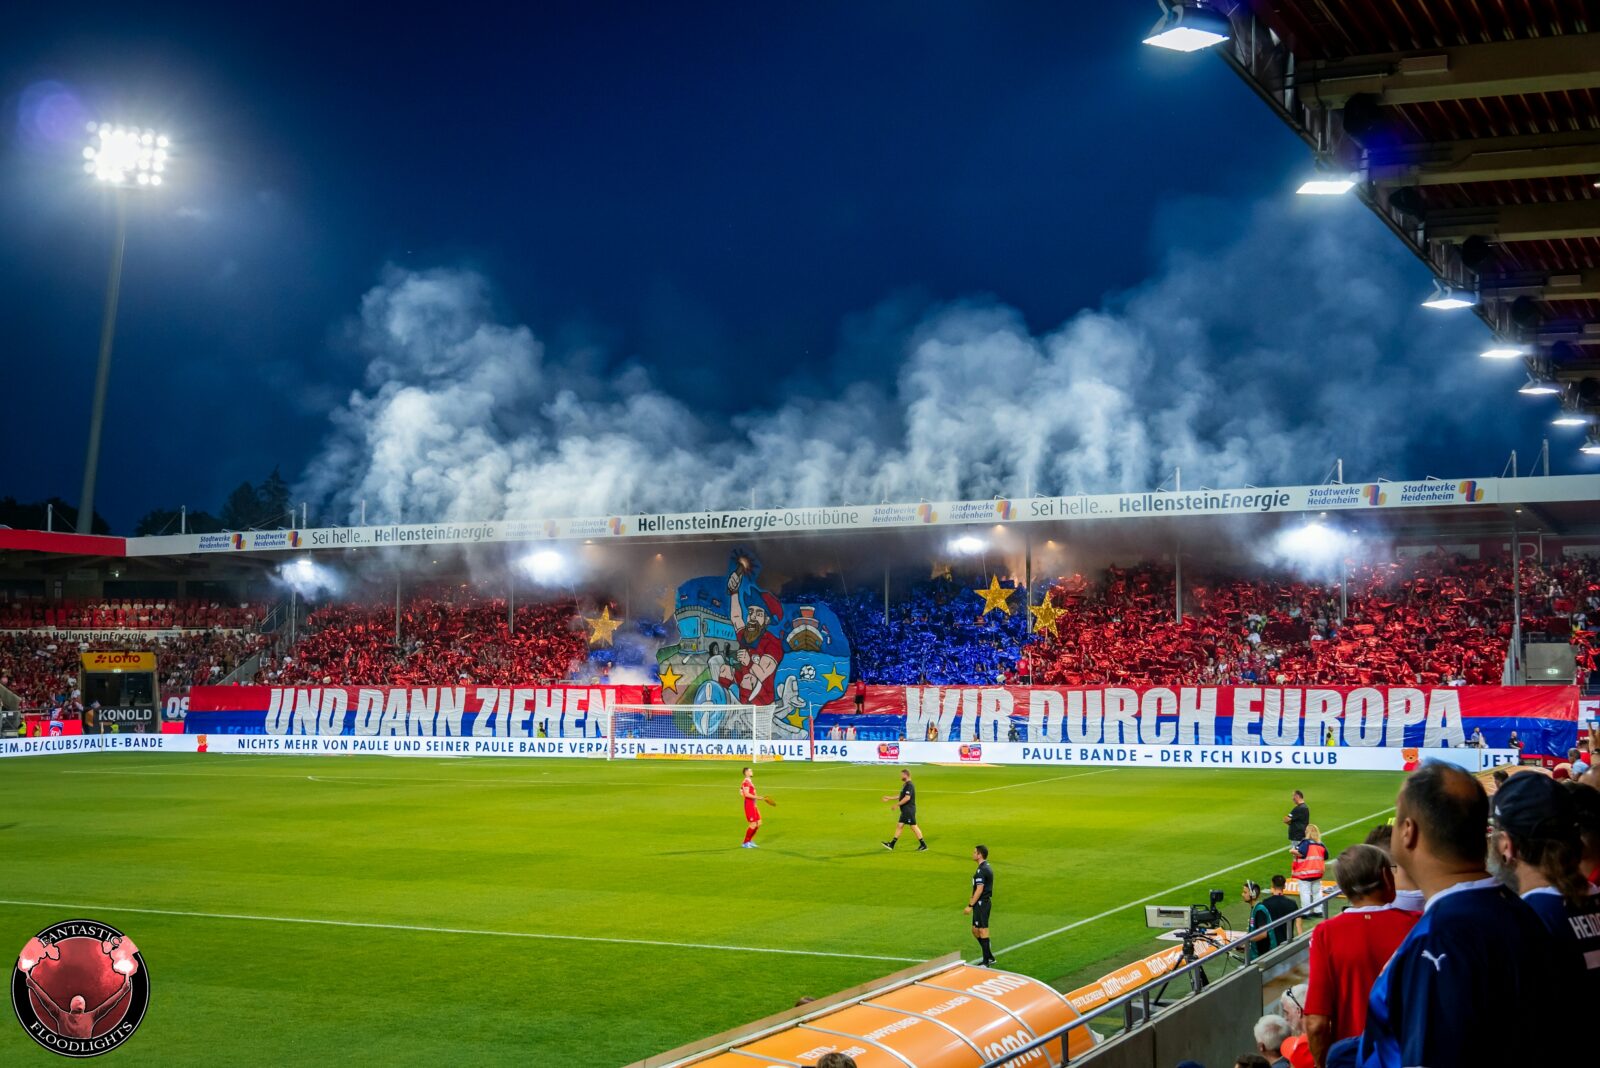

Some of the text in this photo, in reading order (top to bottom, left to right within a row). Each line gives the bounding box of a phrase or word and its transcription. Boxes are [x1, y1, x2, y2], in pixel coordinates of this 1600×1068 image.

[1309, 487, 1360, 496] Stadtwerke
[1403, 483, 1456, 493] Stadtwerke
[1307, 496, 1359, 505] Heidenheim
[1401, 492, 1454, 501] Heidenheim
[951, 503, 994, 512] Stadtwerke
[1031, 490, 1290, 516] Sei helle... HellensteinEnergie
[638, 508, 859, 531] HellensteinEnergie-Osttribüne
[950, 511, 993, 520] Heidenheim
[200, 534, 231, 543] Stadtwerke
[255, 532, 287, 541] Stadtwerke
[312, 530, 328, 544] Sei
[332, 529, 370, 543] helle...
[375, 524, 494, 541] HellensteinEnergie
[108, 653, 141, 664] LOTTO
[99, 709, 152, 720] KONOLD
[265, 686, 1465, 748] UND DANN ZIEHEN WIR DURCH EUROPA
[238, 738, 279, 749] NICHTS
[285, 739, 318, 750] MEHR
[323, 740, 348, 750] VON
[353, 740, 388, 751] PAULE
[394, 740, 420, 751] UND
[426, 741, 470, 752] SEINER
[475, 741, 511, 752] PAULE
[520, 742, 563, 753] BANDE
[1022, 747, 1072, 760] PAULE
[1080, 748, 1137, 761] BANDE
[1161, 750, 1193, 762] DER
[1201, 751, 1233, 763] FCH
[1241, 751, 1283, 764] KIDS
[1292, 752, 1338, 765] CLUB
